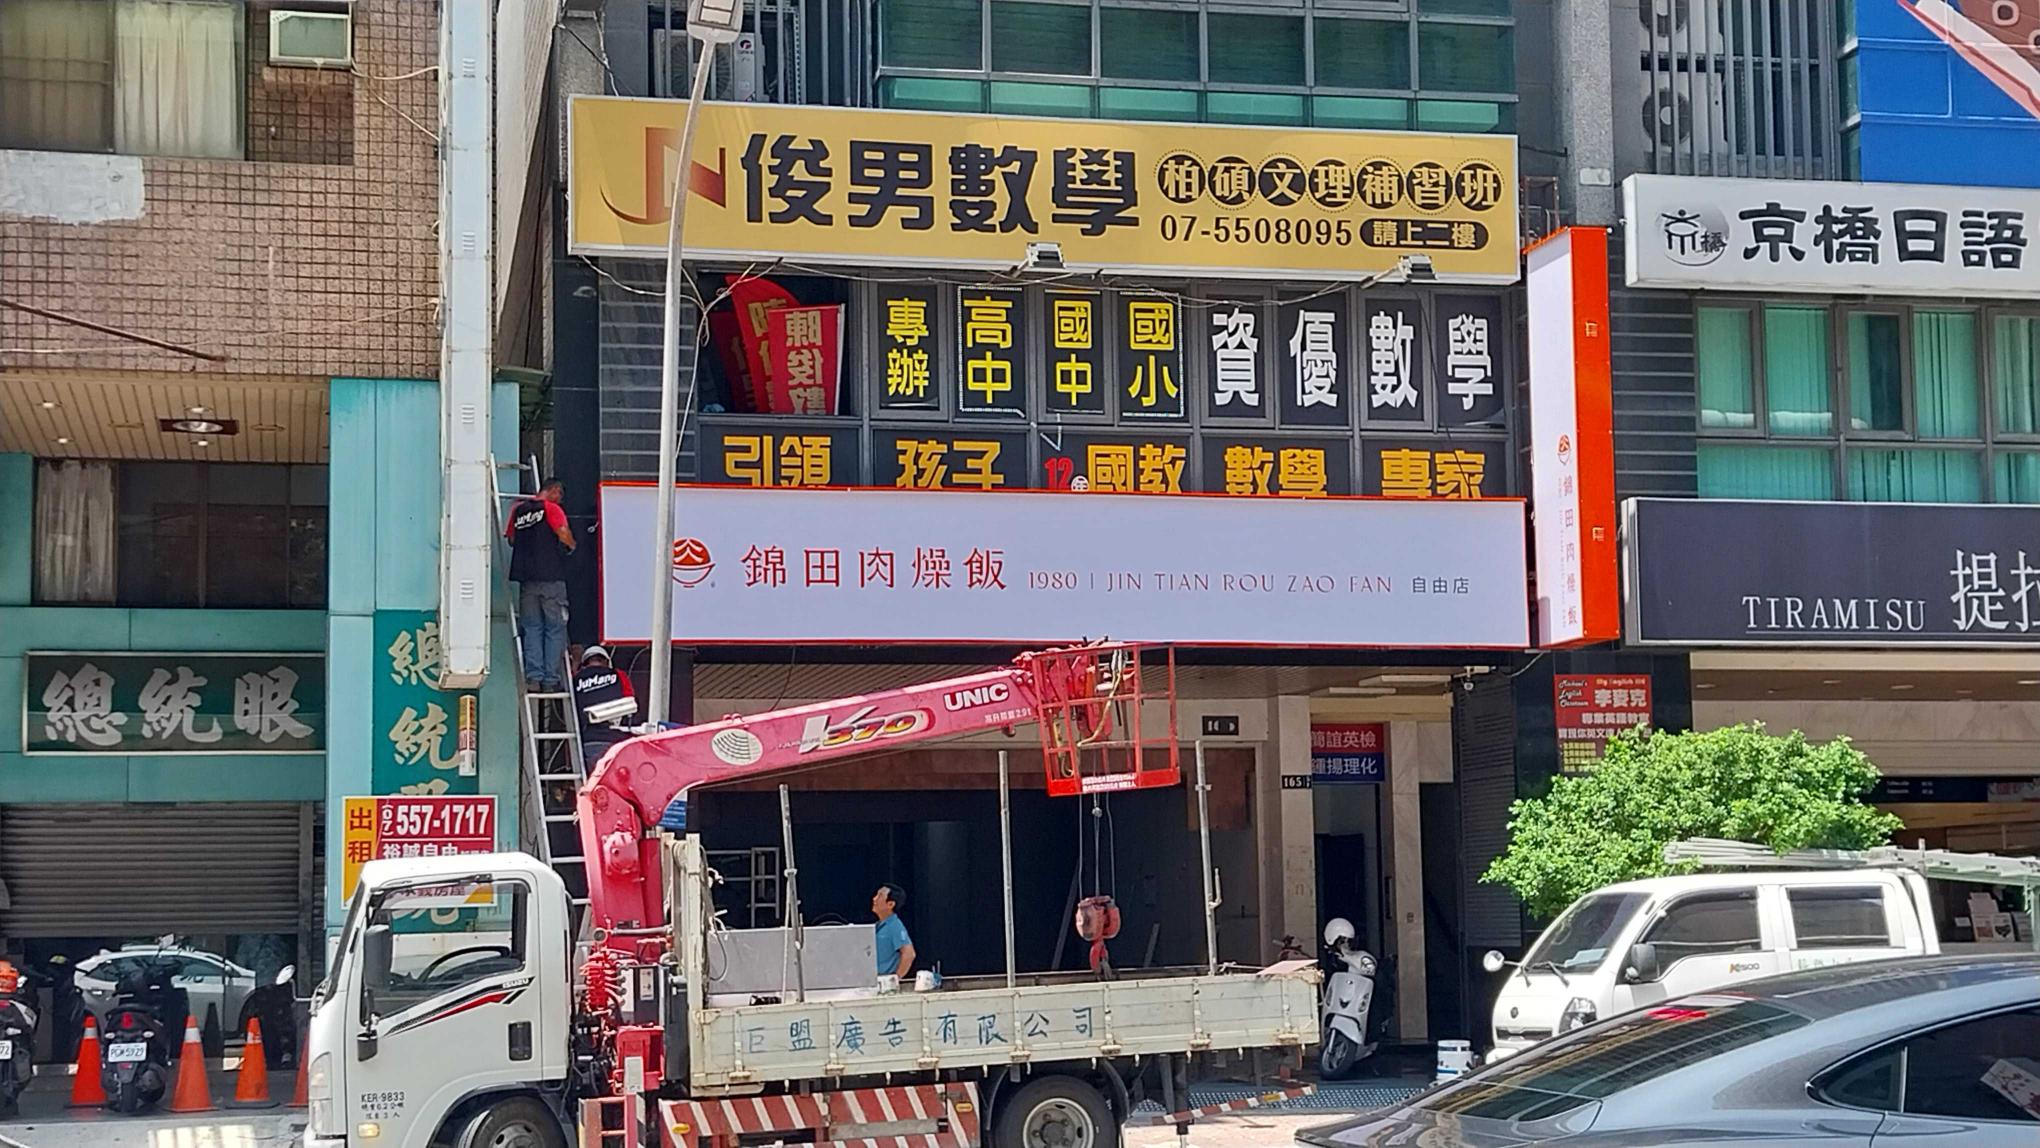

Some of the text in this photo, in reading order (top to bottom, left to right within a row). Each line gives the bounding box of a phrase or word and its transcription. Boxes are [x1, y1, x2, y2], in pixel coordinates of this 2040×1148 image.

[741, 133, 1140, 238] 俊男數學
[1160, 158, 1500, 208] 柏碩文理補習班
[1160, 215, 1352, 245] 07-5508095
[1372, 219, 1477, 248] 請上二樓
[1738, 202, 2028, 270] 京橋日語
[886, 297, 929, 398] 專辦
[963, 296, 1012, 404] 高中
[1054, 299, 1092, 405] 國中
[1128, 302, 1179, 407] 國小
[723, 435, 831, 487] 引領
[896, 440, 1004, 489] 孩子
[1224, 446, 1328, 496] 數學
[740, 544, 1007, 591] 錦田肉燥飯
[1029, 571, 1392, 593] 1980 JIN TIAN ROU ZAO FAN
[1412, 576, 1470, 595] 自由店
[1742, 596, 1925, 631] TIRAMISU
[42, 662, 314, 746] 總統眼
[944, 683, 1009, 712] UNIC
[348, 806, 372, 864] 出租
[396, 804, 490, 836] 557-1717
[748, 1006, 1094, 1056] 巨盟廣告有限公司
